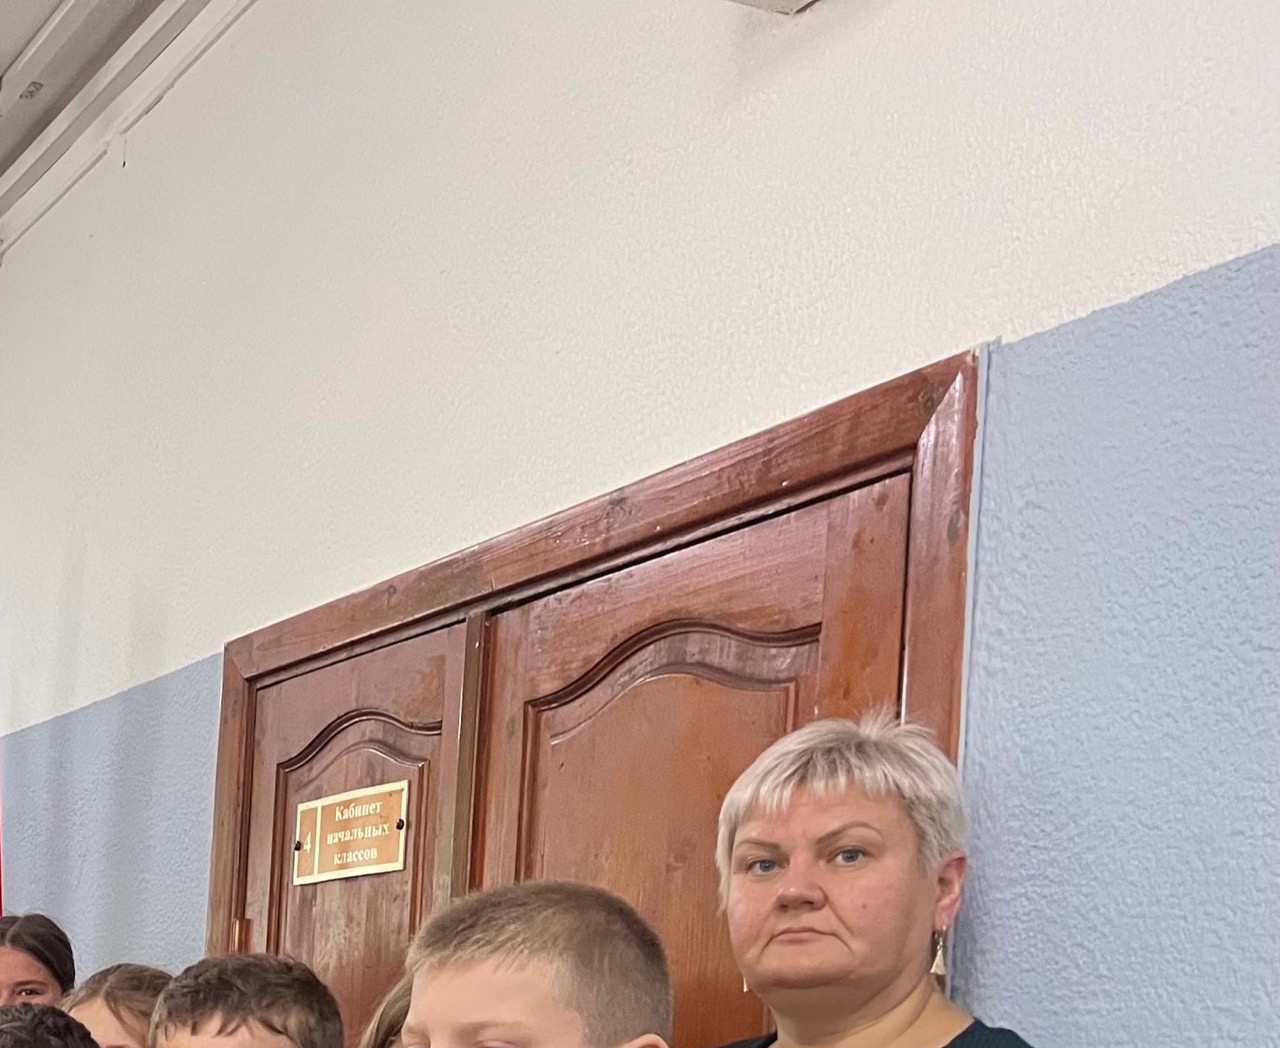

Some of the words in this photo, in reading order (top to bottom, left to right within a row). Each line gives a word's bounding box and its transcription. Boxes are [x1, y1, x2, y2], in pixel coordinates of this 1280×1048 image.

[335, 801, 383, 822] Кабинет
[303, 832, 312, 853] 4
[327, 823, 390, 845] начальных
[333, 847, 378, 865] классов
